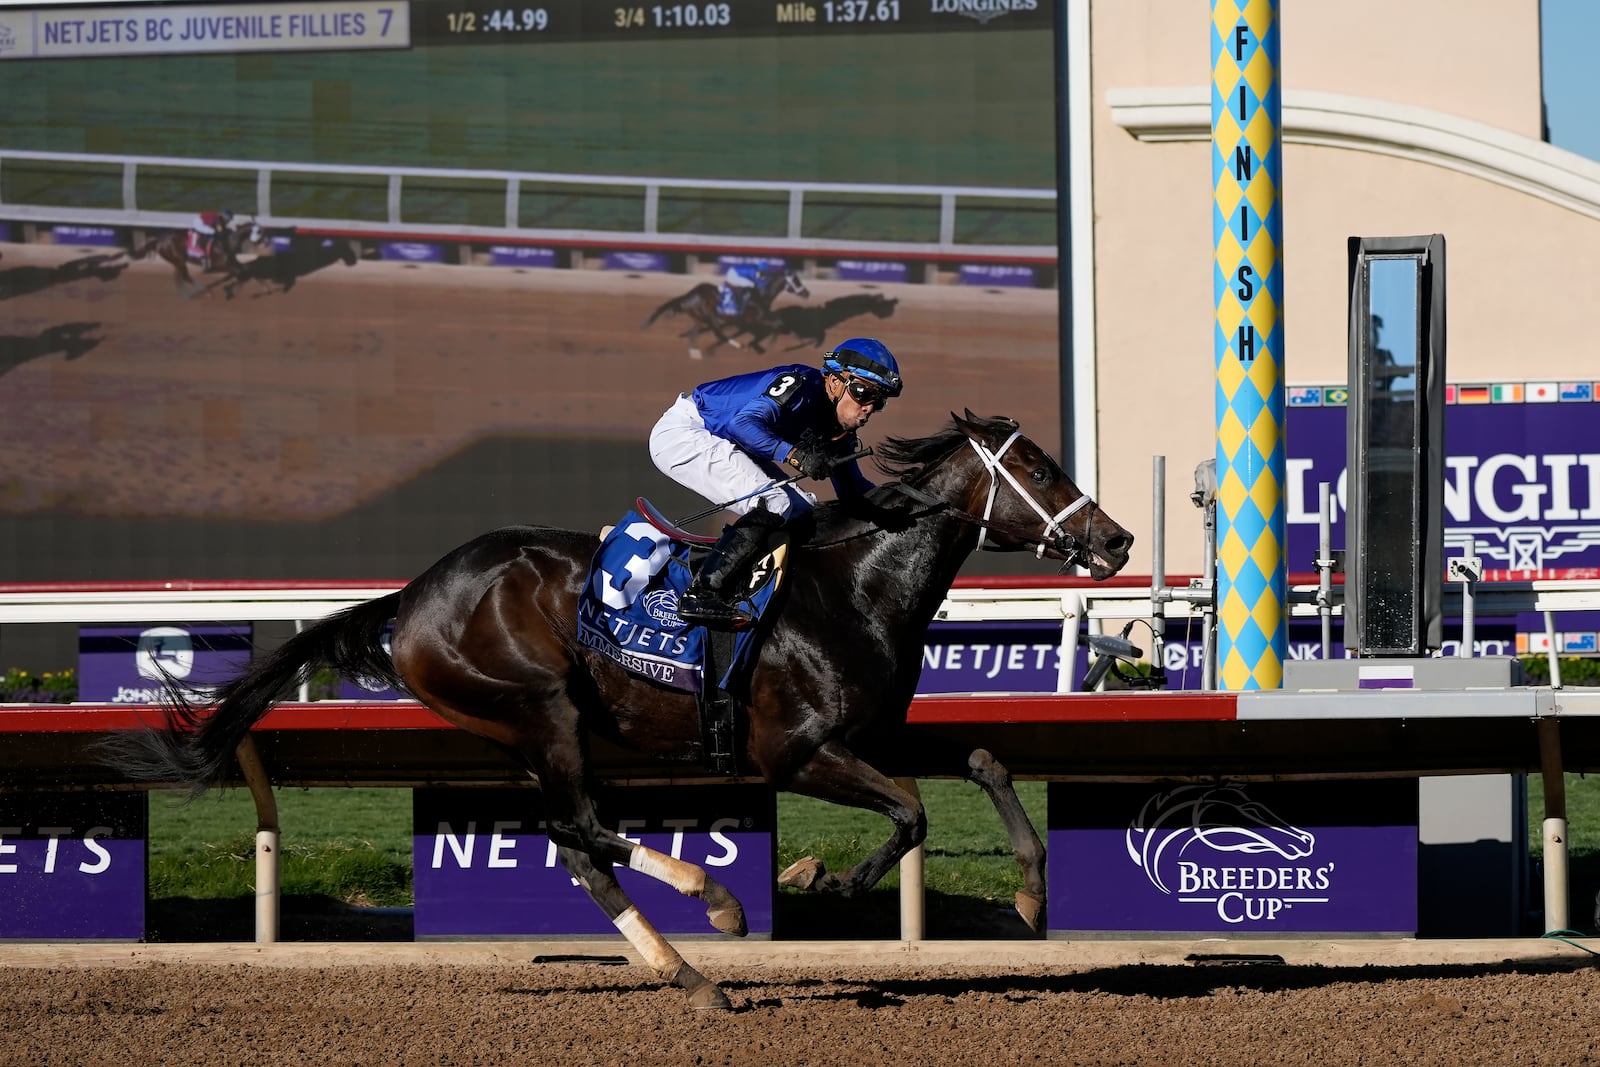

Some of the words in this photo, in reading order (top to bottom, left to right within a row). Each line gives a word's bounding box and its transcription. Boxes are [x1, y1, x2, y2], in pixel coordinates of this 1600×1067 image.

[44, 19, 138, 45] NETJETS
[146, 17, 173, 42] BC
[180, 15, 282, 41] JUVENILE
[288, 13, 365, 38] FILLIES
[377, 9, 394, 37] 7
[447, 13, 476, 32] 1/2
[482, 8, 548, 31] :44.99
[614, 8, 646, 28] 3/4
[652, 4, 731, 27] 1:10.03
[776, 4, 816, 24] Mile
[824, 0, 901, 23] 1:37.61
[1235, 26, 1255, 362] FINISH
[768, 375, 796, 397] 3
[1286, 453, 1600, 524] LNGI
[602, 522, 671, 610] 3
[580, 598, 689, 655] NETJETS
[579, 629, 675, 683] MMERSIVE
[1177, 862, 1335, 893] BREEDERS'
